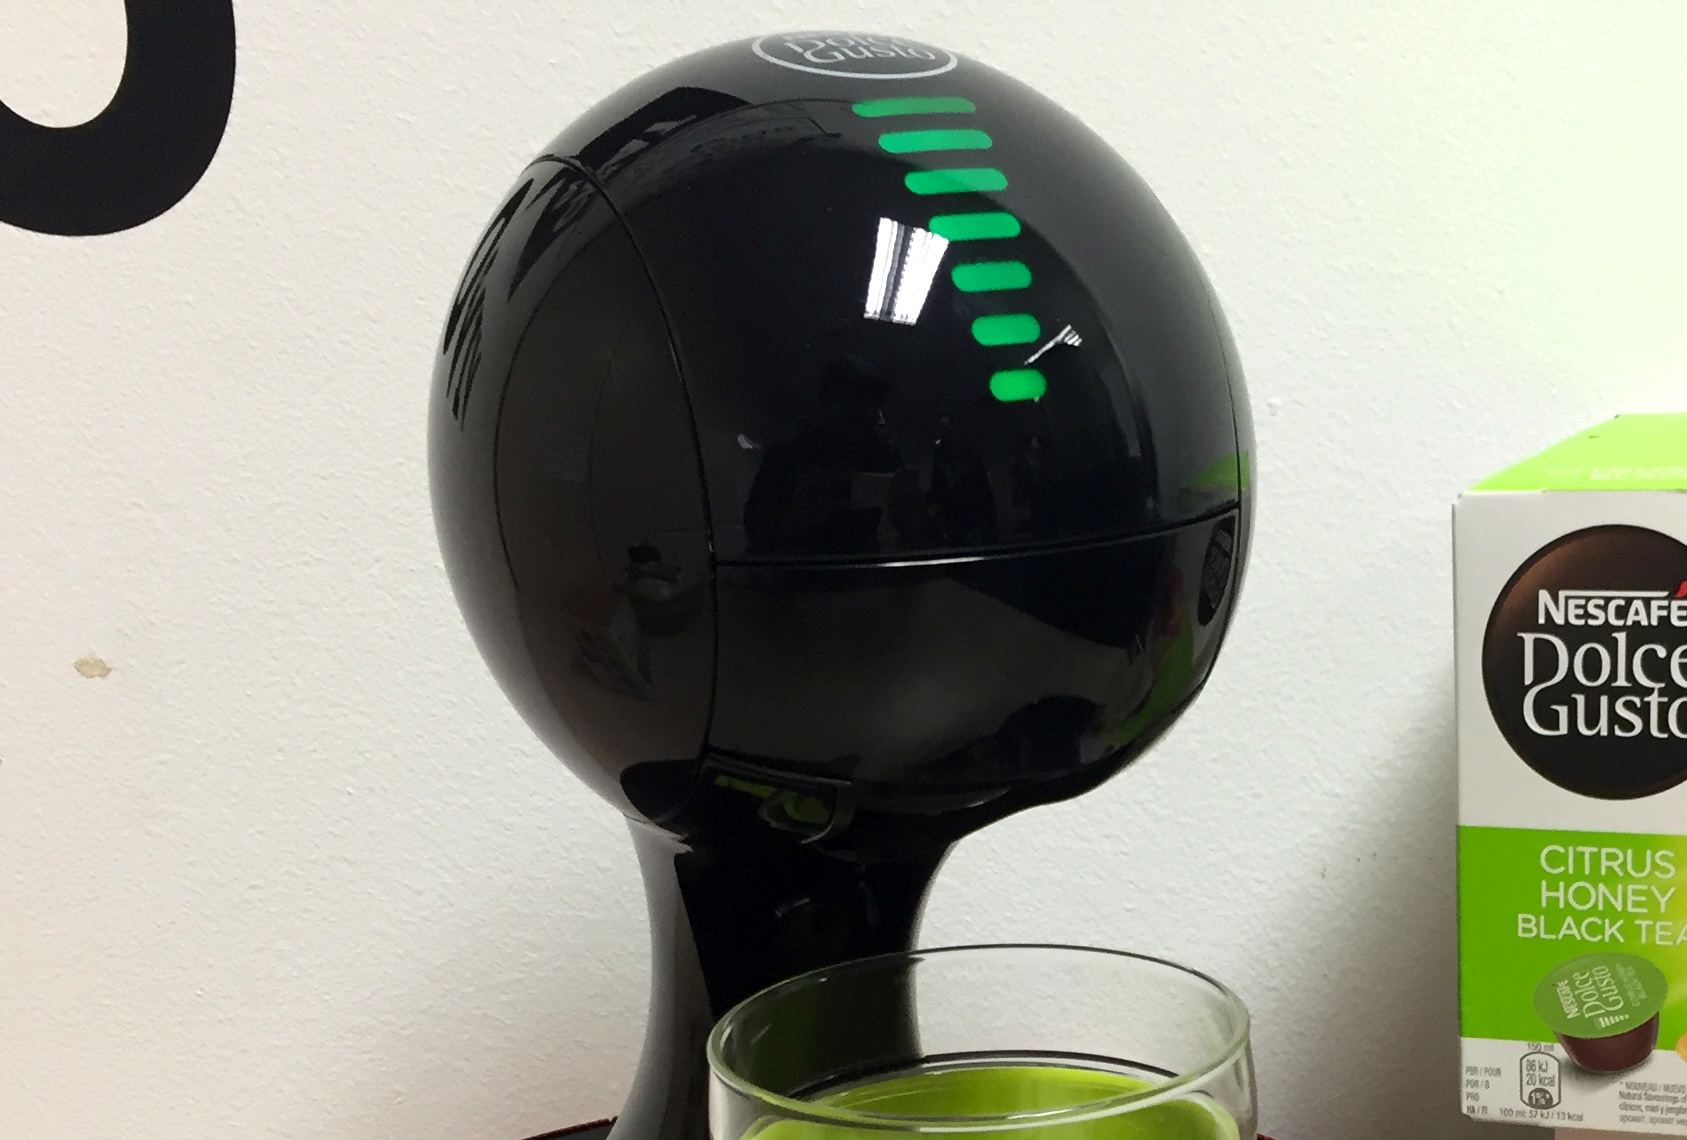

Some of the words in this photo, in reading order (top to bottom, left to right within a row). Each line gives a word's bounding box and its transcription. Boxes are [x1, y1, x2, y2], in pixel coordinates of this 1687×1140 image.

[803, 44, 936, 63] Gusto
[1539, 844, 1676, 879] CITRUS
[1540, 880, 1676, 914] HONEY
[1517, 912, 1625, 943] BLACK
[1572, 971, 1606, 1018] Dolce
[1591, 965, 1624, 1011] Gusto
[1526, 1073, 1537, 1086] 20
